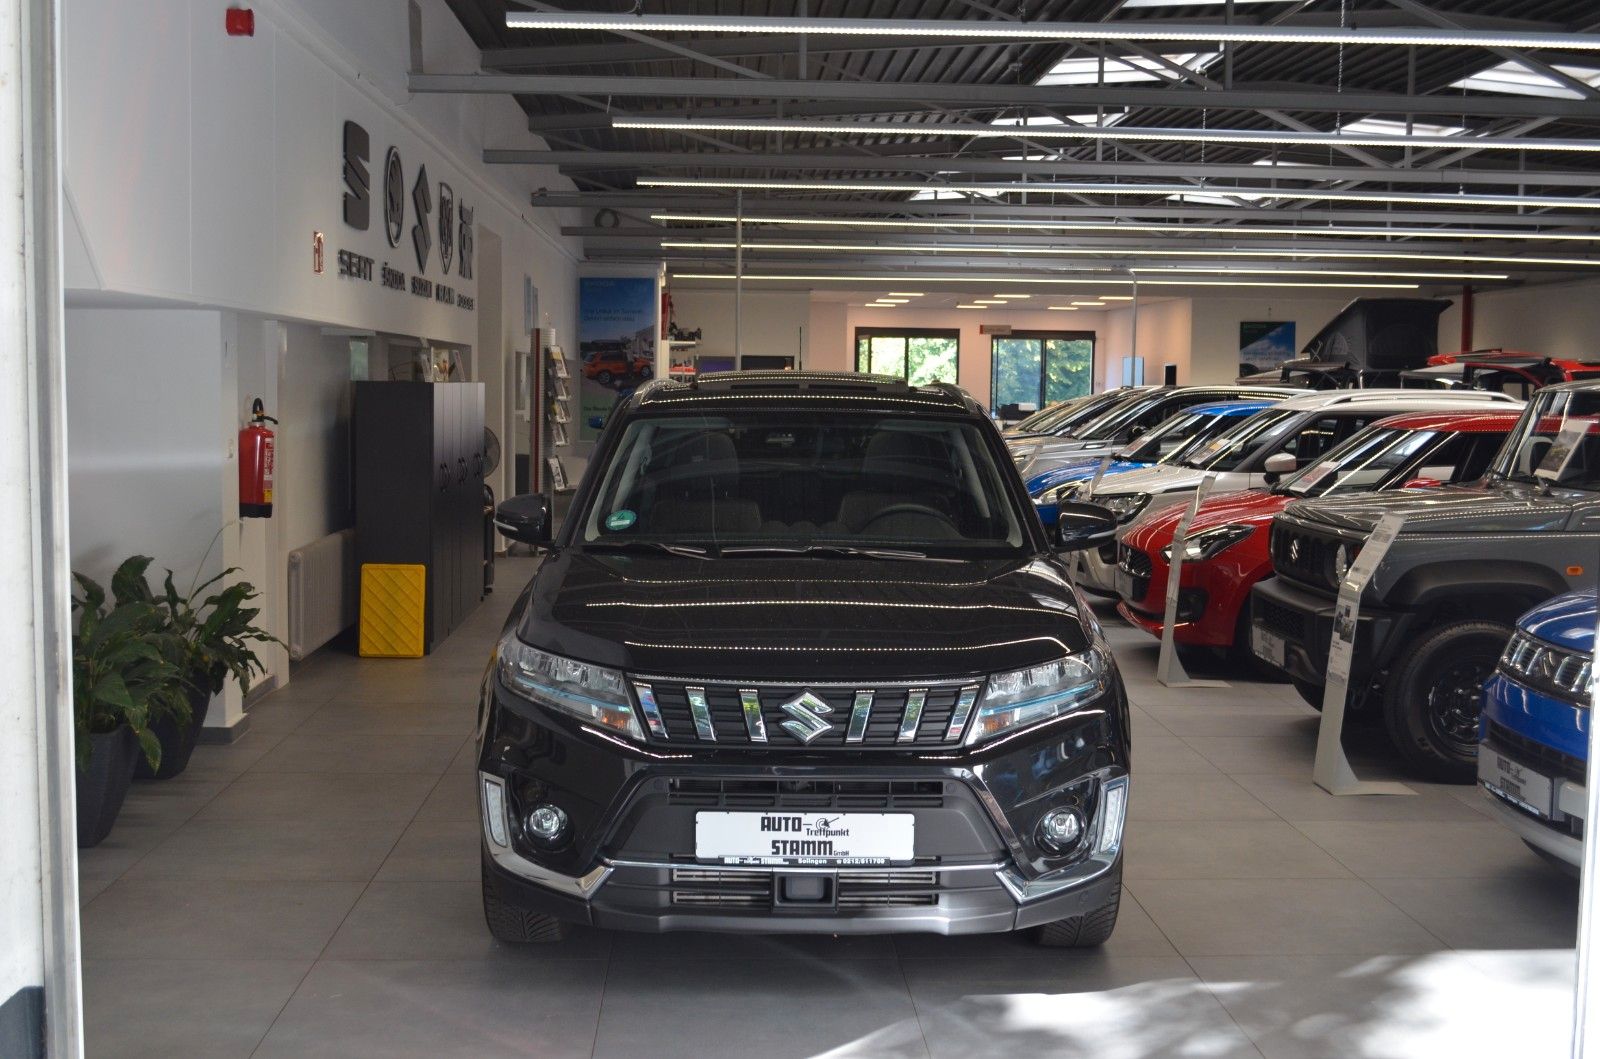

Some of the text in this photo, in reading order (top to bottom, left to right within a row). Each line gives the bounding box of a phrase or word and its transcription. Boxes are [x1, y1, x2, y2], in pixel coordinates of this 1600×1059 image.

[338, 249, 375, 281] SEAT
[806, 828, 850, 838] Treffpunkt
[771, 840, 833, 856] STAMM
[797, 857, 827, 865] Solingen
